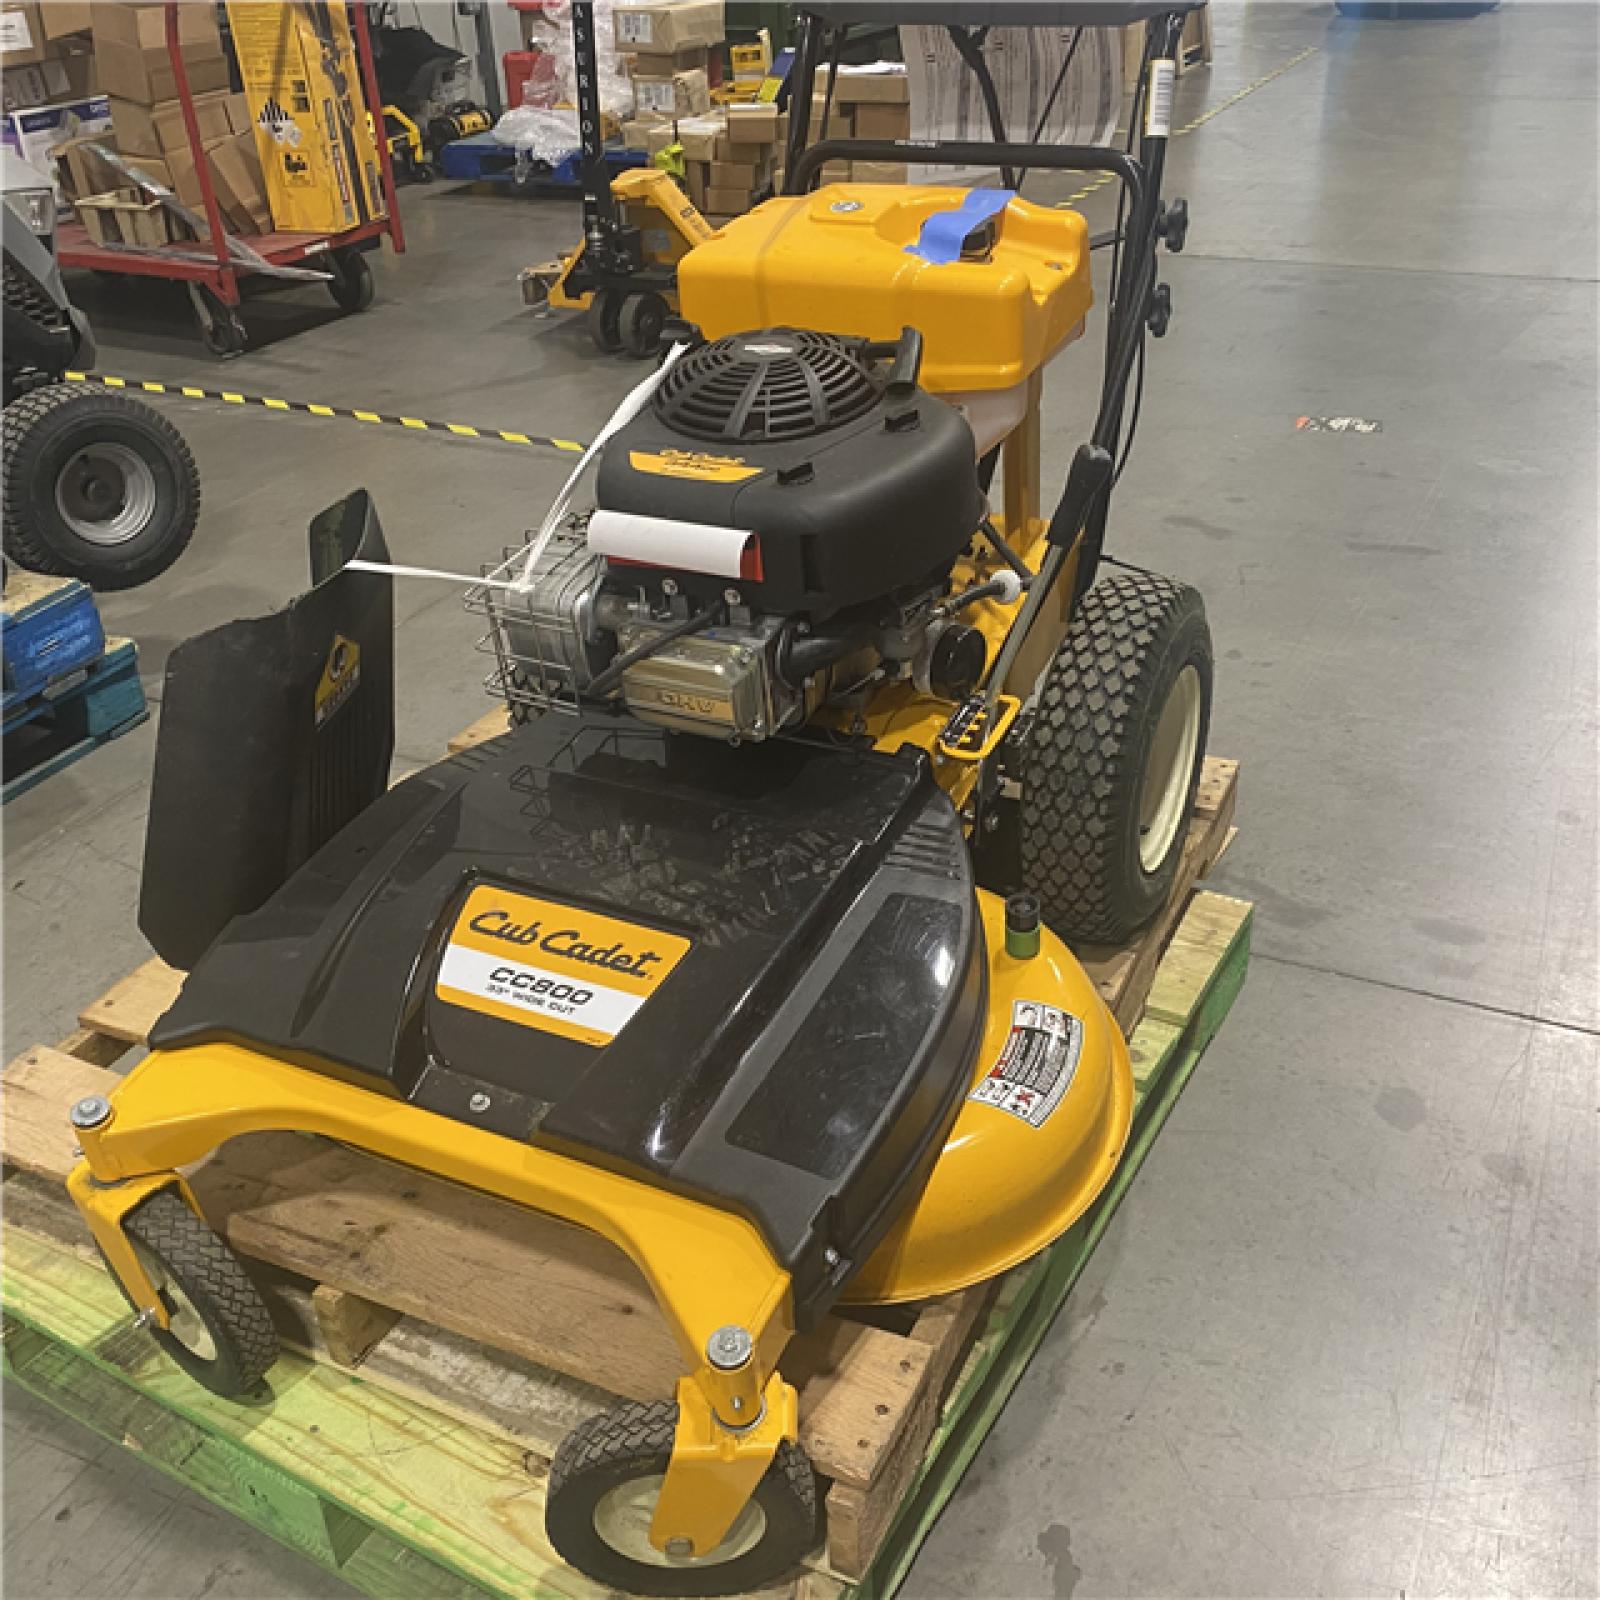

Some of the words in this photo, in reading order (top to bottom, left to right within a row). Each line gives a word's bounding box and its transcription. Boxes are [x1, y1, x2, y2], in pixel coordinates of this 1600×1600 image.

[469, 911, 542, 945] Cub
[540, 929, 662, 978] Cadet
[489, 966, 594, 1006] CC800
